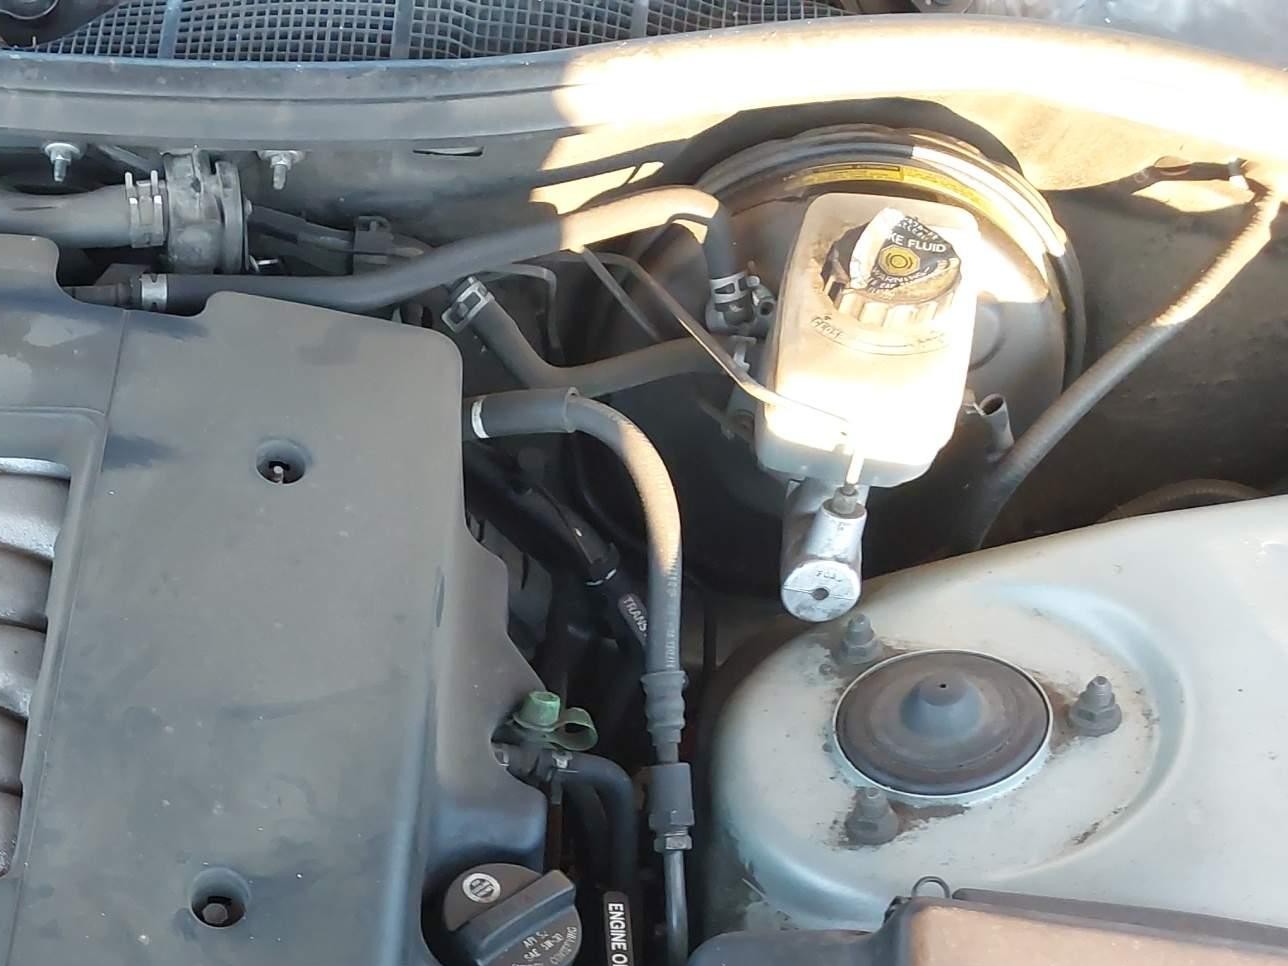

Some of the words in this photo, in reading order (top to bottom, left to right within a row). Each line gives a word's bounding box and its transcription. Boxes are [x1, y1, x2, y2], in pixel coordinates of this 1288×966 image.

[907, 238, 947, 253] FLUID
[608, 903, 627, 951] ENGINE
[523, 949, 541, 961] SAE
